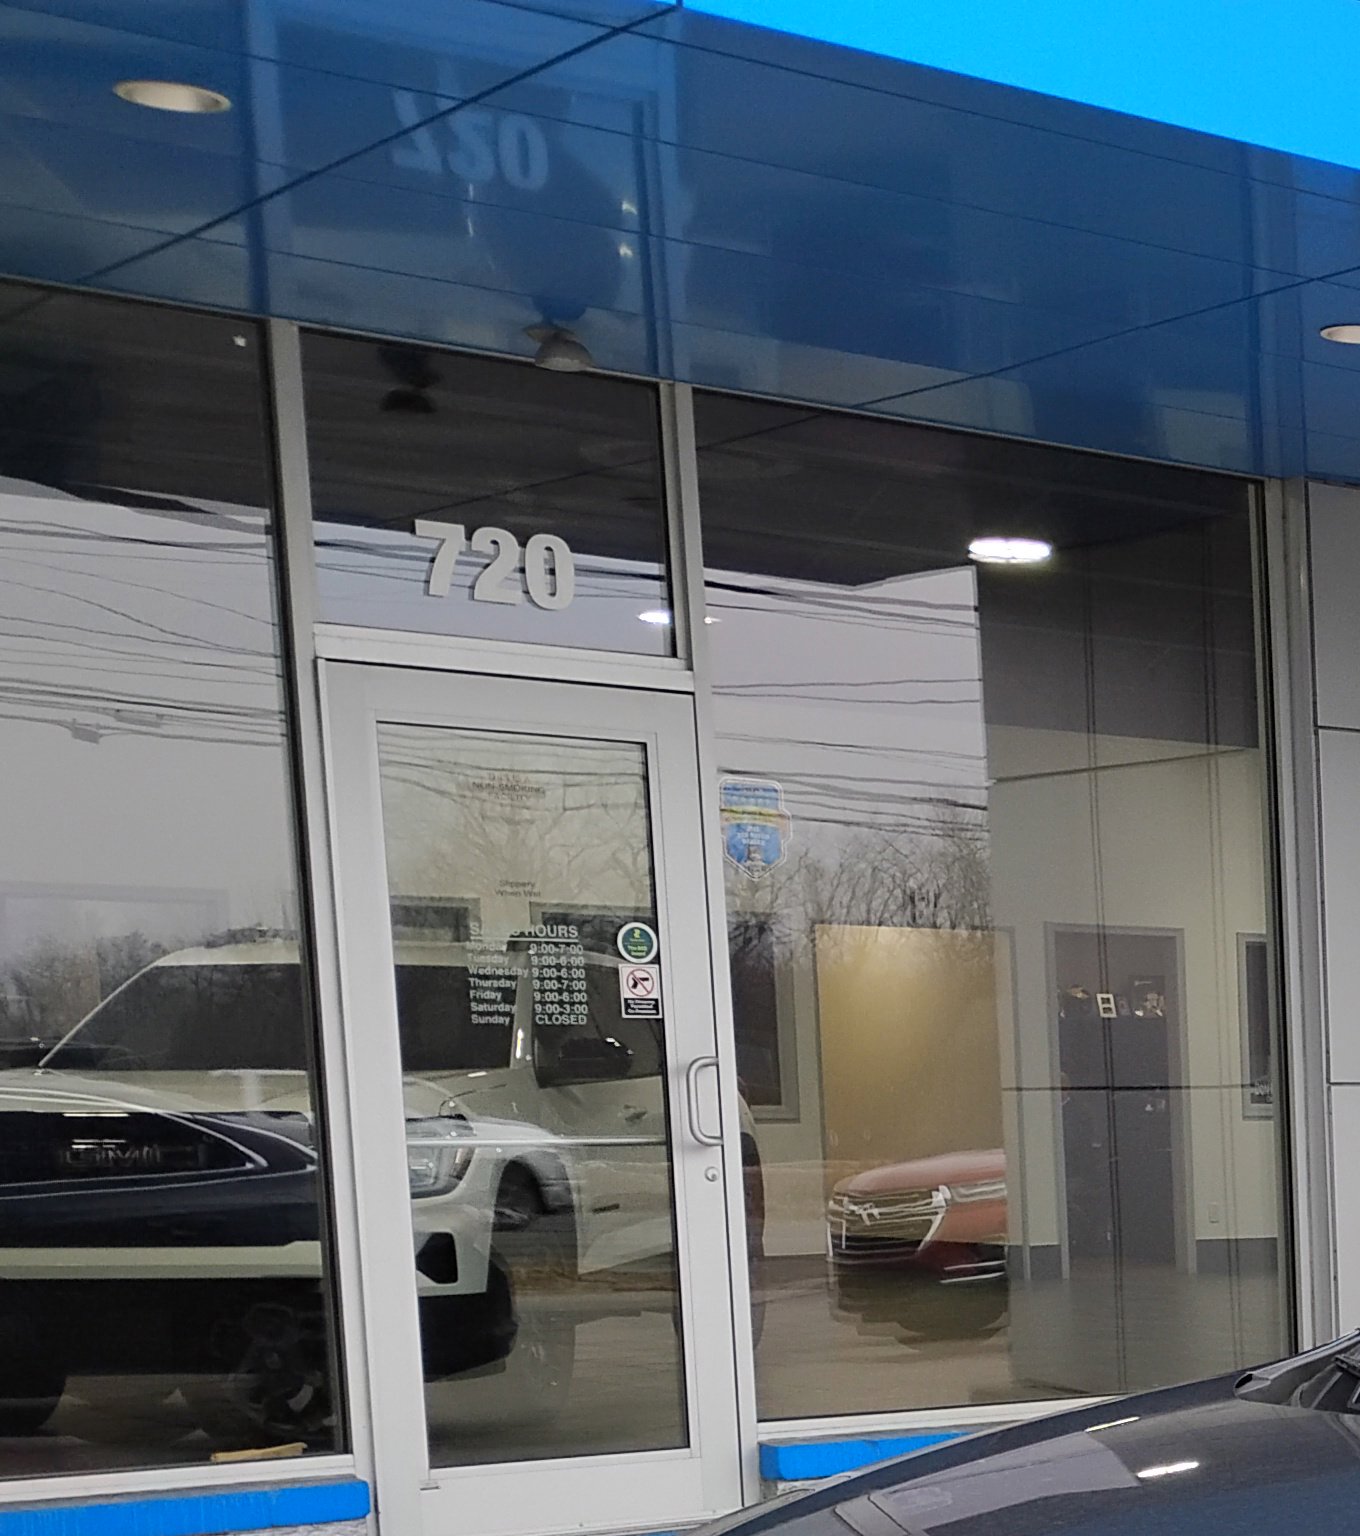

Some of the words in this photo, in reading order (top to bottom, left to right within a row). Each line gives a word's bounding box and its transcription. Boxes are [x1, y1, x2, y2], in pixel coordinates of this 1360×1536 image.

[414, 518, 575, 611] 720
[524, 924, 579, 938] HOURS
[529, 943, 584, 955] 9:00-7:00
[530, 955, 585, 966] 9:00-6:00
[467, 965, 529, 978] Wednesday
[531, 967, 586, 978] 9:00-6:00
[469, 977, 517, 990] Thursday
[532, 979, 587, 990] 9:00-7:00
[469, 989, 502, 1001] Friday
[533, 991, 588, 1002] 9:00-6:00
[470, 1001, 516, 1014] Saturday
[534, 1003, 588, 1014] 9:00-3:00
[470, 1013, 511, 1026] Sunday
[535, 1014, 588, 1025] CLOSED
